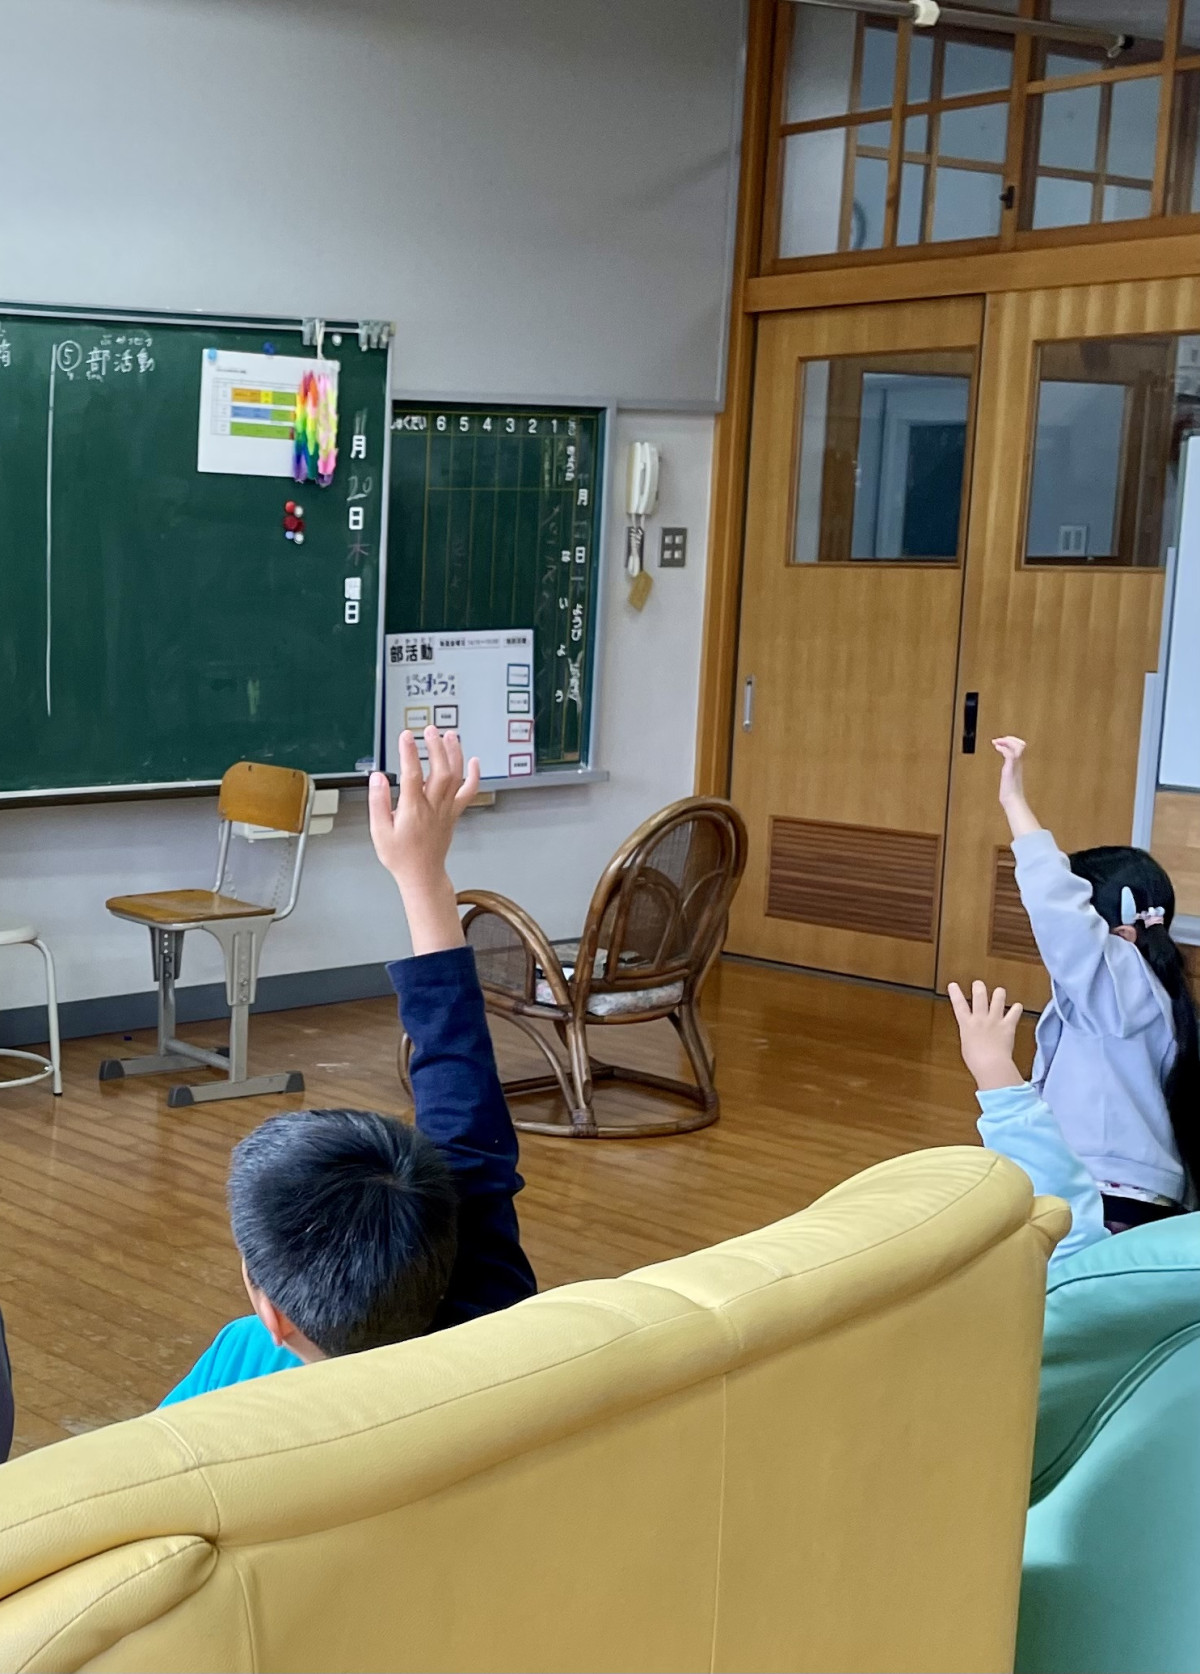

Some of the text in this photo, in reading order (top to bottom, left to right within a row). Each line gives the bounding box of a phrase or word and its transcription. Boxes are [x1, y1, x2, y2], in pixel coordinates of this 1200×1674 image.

[436, 415, 447, 432] 6
[459, 416, 470, 432] 5
[482, 417, 492, 432] 4
[505, 418, 516, 433] 3
[528, 418, 538, 434] 2
[551, 419, 558, 434] 1
[390, 644, 434, 663] 部活動
